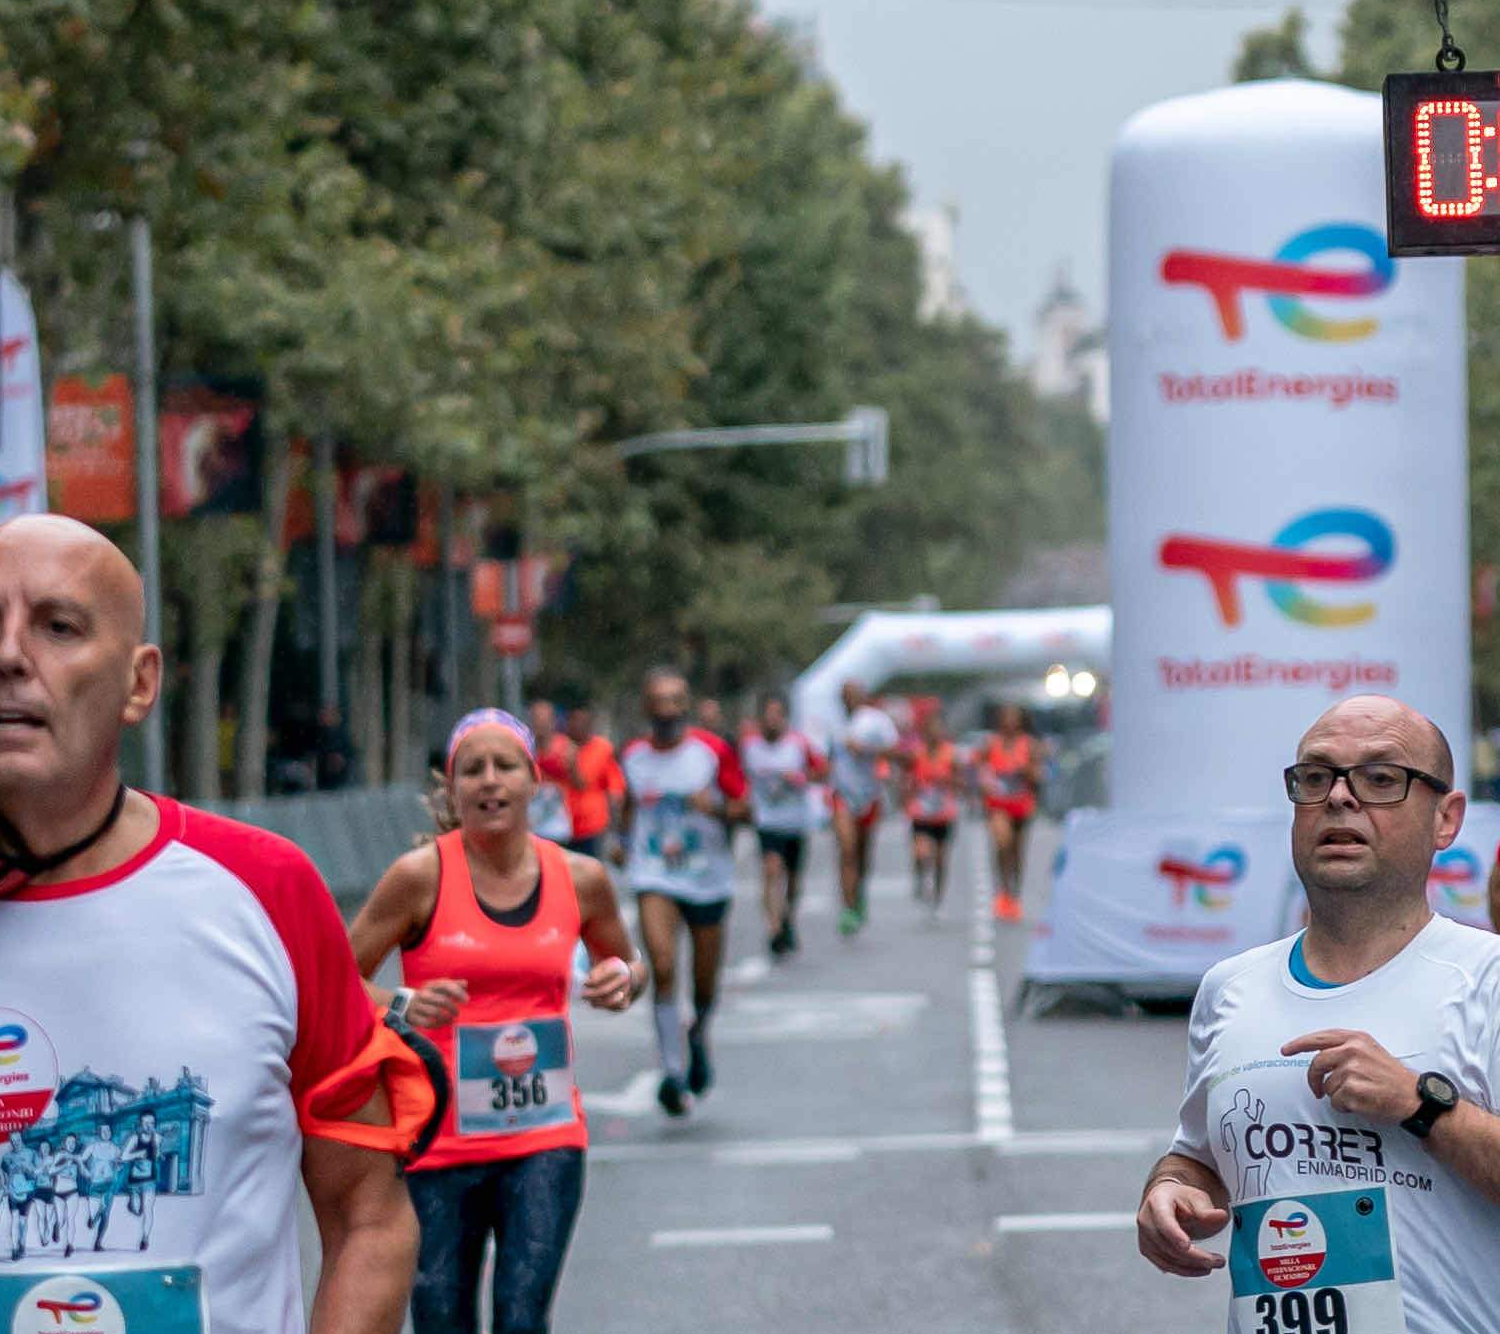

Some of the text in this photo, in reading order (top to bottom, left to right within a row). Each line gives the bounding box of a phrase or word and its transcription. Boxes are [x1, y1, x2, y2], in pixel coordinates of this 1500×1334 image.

[1159, 368, 1399, 406] TotalEnergies
[1157, 654, 1399, 692] TotalEnergies
[491, 1075, 547, 1110] 356
[1297, 1160, 1432, 1191] ENMADRID.COM
